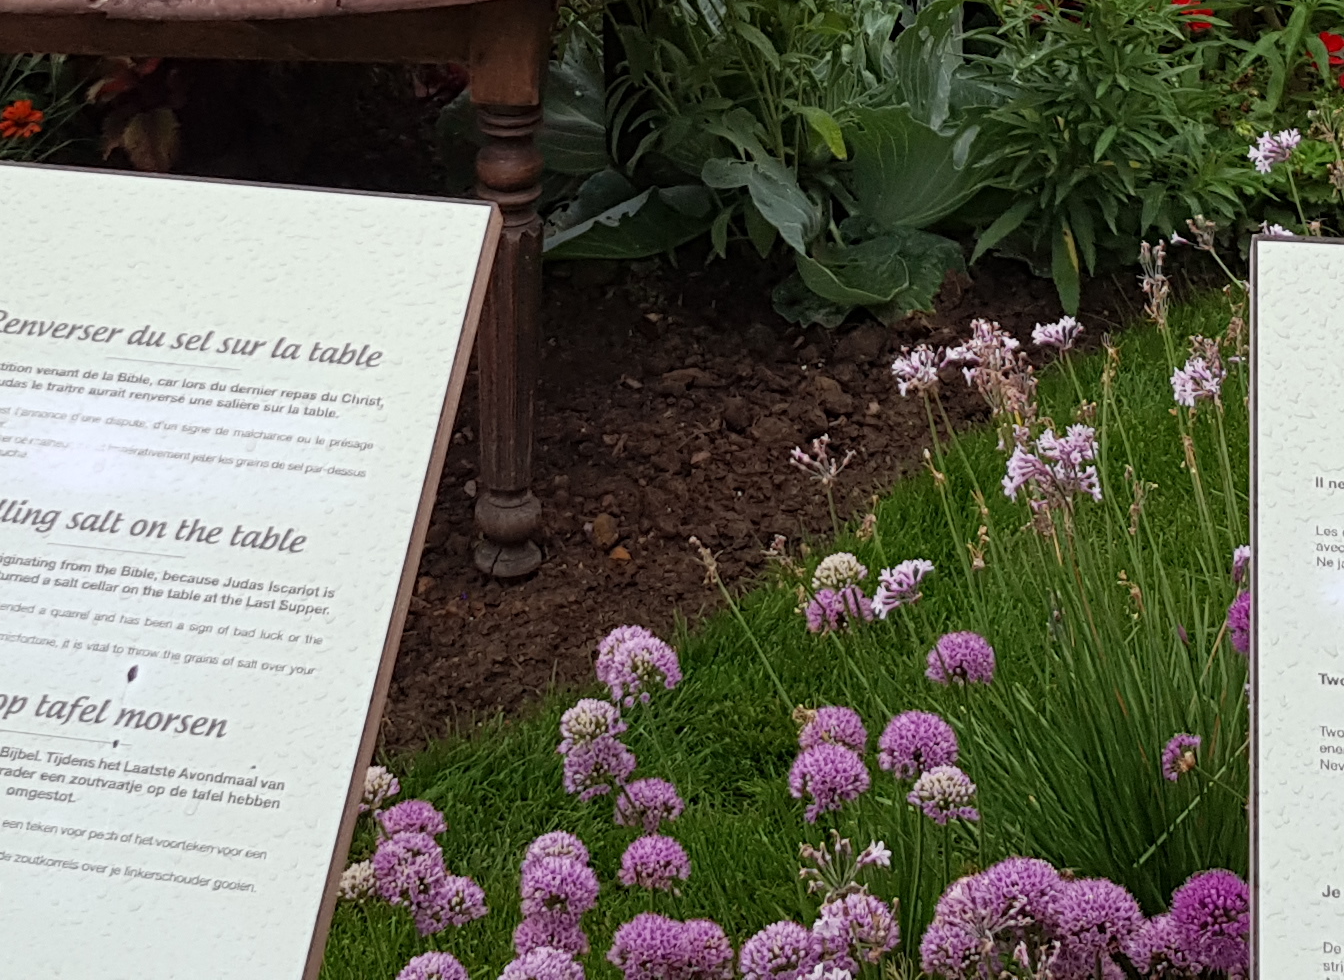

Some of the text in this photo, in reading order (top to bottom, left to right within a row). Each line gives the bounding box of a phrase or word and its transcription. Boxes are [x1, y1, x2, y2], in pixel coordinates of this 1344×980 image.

[126, 324, 166, 347] du
[168, 329, 215, 352] sel
[214, 336, 267, 356] sur
[269, 336, 302, 360] la
[307, 341, 383, 368] table
[35, 366, 80, 378] venant
[81, 369, 99, 380] de
[100, 370, 114, 381] la
[115, 371, 153, 387] Bible,
[155, 377, 180, 387] car
[180, 377, 206, 390] lors
[208, 380, 227, 392] du
[228, 382, 278, 396] dernier
[279, 389, 317, 401] repas
[319, 391, 338, 403] du
[340, 392, 384, 411] Christ,
[1314, 475, 1324, 488] Il
[64, 509, 124, 534] salt
[128, 518, 167, 539] on
[173, 518, 223, 544] the
[228, 524, 307, 553] table
[58, 558, 92, 573] from
[94, 563, 117, 576] the
[119, 564, 158, 582] Bible,
[160, 569, 220, 587] because
[221, 576, 264, 591] Judas
[266, 580, 320, 598] Iscariot
[321, 585, 336, 599] is
[1315, 555, 1334, 568] Ne
[41, 576, 51, 586] a
[52, 576, 79, 588] salt
[80, 579, 120, 593] cellar
[120, 584, 139, 595] on
[140, 584, 164, 598] the
[166, 587, 201, 602] table
[201, 592, 218, 604] at
[219, 593, 243, 606] the
[244, 595, 276, 610] Last
[277, 598, 329, 615] Supper.
[33, 693, 112, 725] tafel
[112, 707, 227, 738] morsen
[38, 771, 66, 783] een
[66, 774, 143, 794] zoutvaatje
[145, 784, 166, 797] op
[168, 784, 188, 798] de
[190, 787, 224, 802] tafel
[226, 790, 280, 809] hebben
[45, 750, 96, 769] Tijdens
[96, 756, 122, 771] het
[122, 759, 176, 779] Laatste
[176, 767, 258, 788] Avondmaal
[259, 779, 286, 792] van
[1321, 884, 1341, 899] Je
